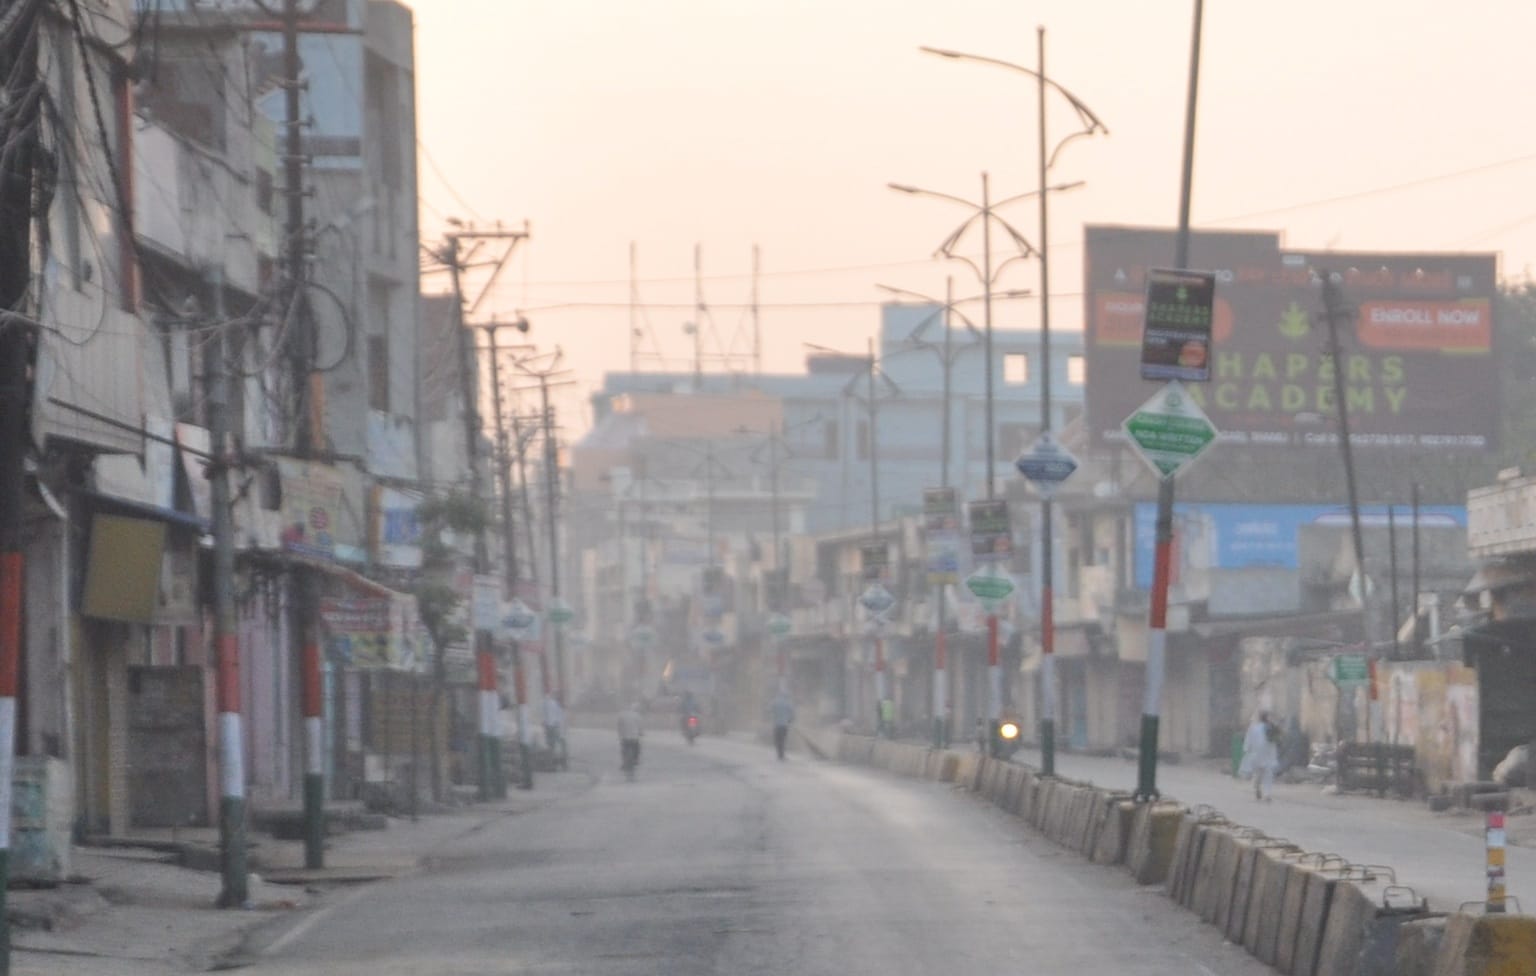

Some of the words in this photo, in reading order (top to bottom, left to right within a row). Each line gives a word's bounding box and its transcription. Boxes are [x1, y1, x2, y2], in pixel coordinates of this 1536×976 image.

[1370, 308, 1434, 327] ENROLL
[1438, 309, 1482, 326] NOW
[1217, 351, 1406, 383] HAPERS
